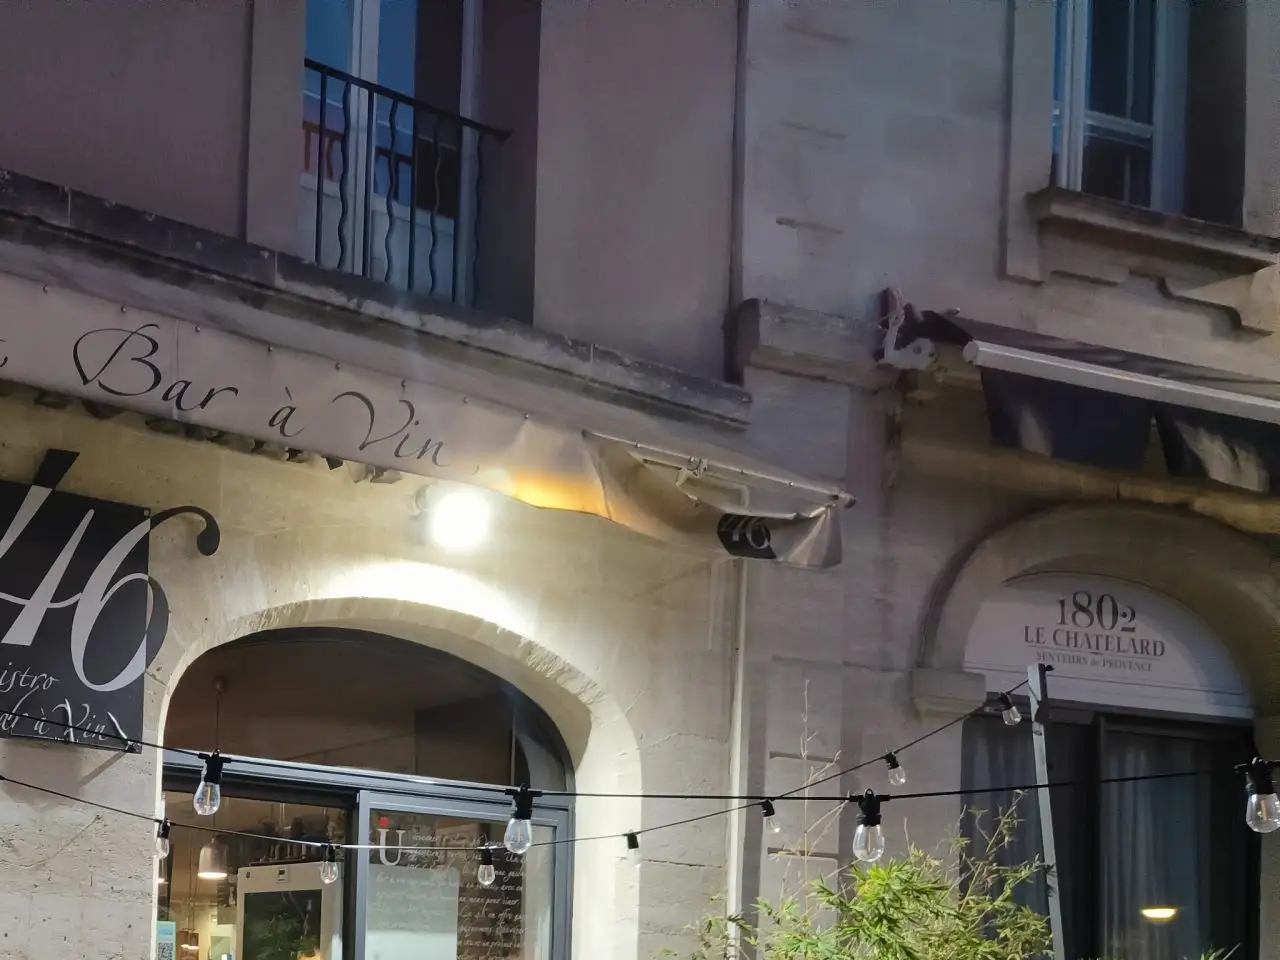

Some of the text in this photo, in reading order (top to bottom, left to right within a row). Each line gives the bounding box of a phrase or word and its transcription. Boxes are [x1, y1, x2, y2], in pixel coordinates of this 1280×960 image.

[72, 324, 239, 412] Bar
[268, 386, 305, 438] à
[332, 390, 452, 467] Vin
[1057, 590, 1137, 633] 1802
[1024, 625, 1166, 658] LE CHATELARD
[33, 707, 50, 736] à
[51, 702, 109, 741] Vin
